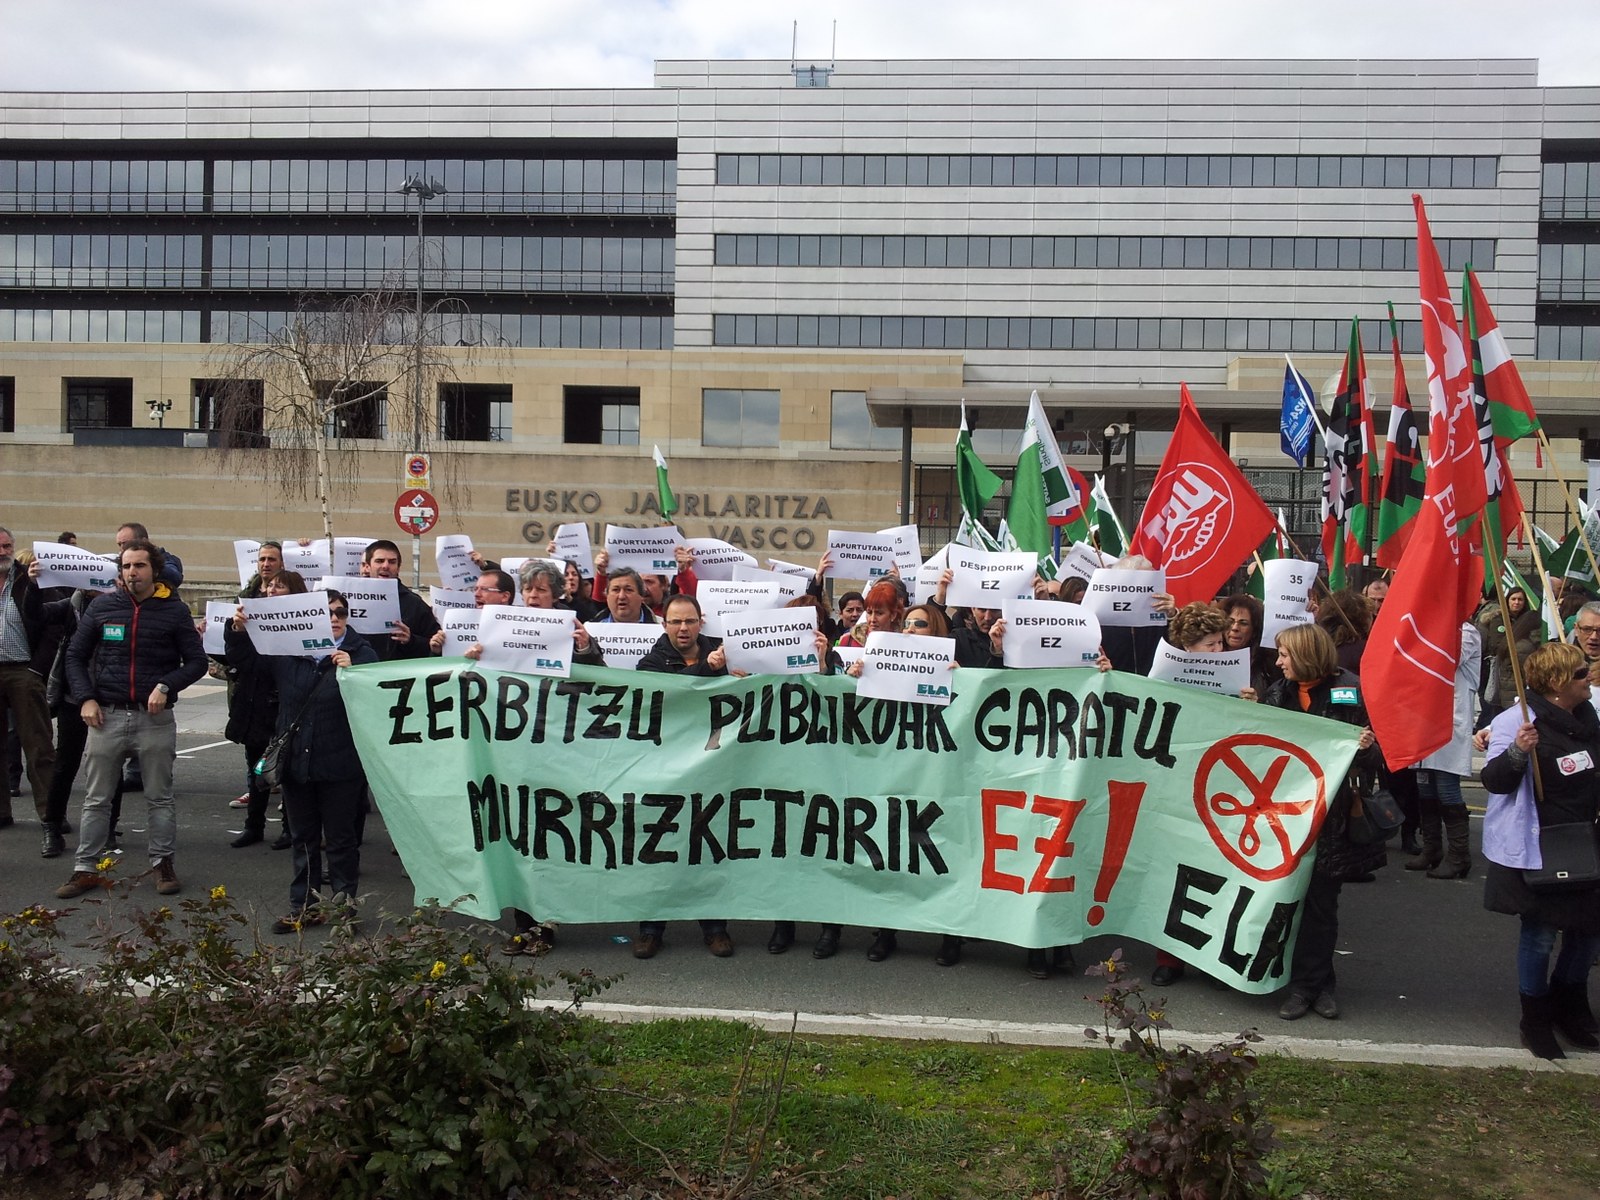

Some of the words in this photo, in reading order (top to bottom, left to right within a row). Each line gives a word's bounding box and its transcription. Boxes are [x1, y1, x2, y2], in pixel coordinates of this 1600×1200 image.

[505, 488, 601, 513] EUSKO
[624, 491, 832, 519] JARLARITZA
[830, 542, 893, 552] LAPURTUTAKOA
[702, 556, 744, 565] ORDAINDU
[839, 552, 883, 562] ORDAINDU
[50, 564, 104, 572] ORDAINDU
[652, 560, 678, 568] ELA
[960, 560, 1025, 572] DESPIDORIK
[1290, 574, 1303, 585] 35
[981, 580, 1000, 590] EZ
[1092, 584, 1154, 593] DESPIDORIK
[709, 587, 770, 595] ORDEZKAPENAK
[342, 592, 388, 601] SPIDORIK
[1113, 602, 1132, 611] EZ
[248, 608, 326, 622] APURTUTAKOA
[351, 609, 367, 618] EZ
[1149, 612, 1166, 621] ELA
[495, 613, 564, 625] ORDEZKAPENAK
[1015, 617, 1087, 627] DESPIDORIK
[105, 627, 122, 636] ELA
[258, 623, 313, 633] ORDAINDU
[512, 628, 540, 637] LEHEN
[726, 623, 813, 638] LAPURTUTAKOA
[301, 638, 335, 649] ELA
[502, 641, 548, 651] EGUNETIK
[742, 637, 801, 650] ORDAINDU
[1040, 637, 1062, 648] EZ
[786, 654, 818, 666] ELA
[864, 648, 950, 662] LAPURTUTAKOA
[1081, 652, 1100, 661] ELA
[1164, 652, 1240, 666] ORDEZKAPENAK
[535, 658, 564, 669] ELA
[876, 661, 935, 674] ORDAINDU
[1183, 668, 1215, 676] LEHEN
[1173, 677, 1222, 688] EGUNETIK
[917, 684, 950, 696] ELA
[1332, 690, 1356, 700] ELA
[378, 670, 665, 746] ZERBITZU
[704, 682, 958, 753] PUBLIKOAK
[975, 687, 1182, 769] GARATU
[466, 774, 950, 875] MURRIZKETARIK
[980, 780, 1148, 927] EZ!
[1163, 863, 1300, 982] ELA
